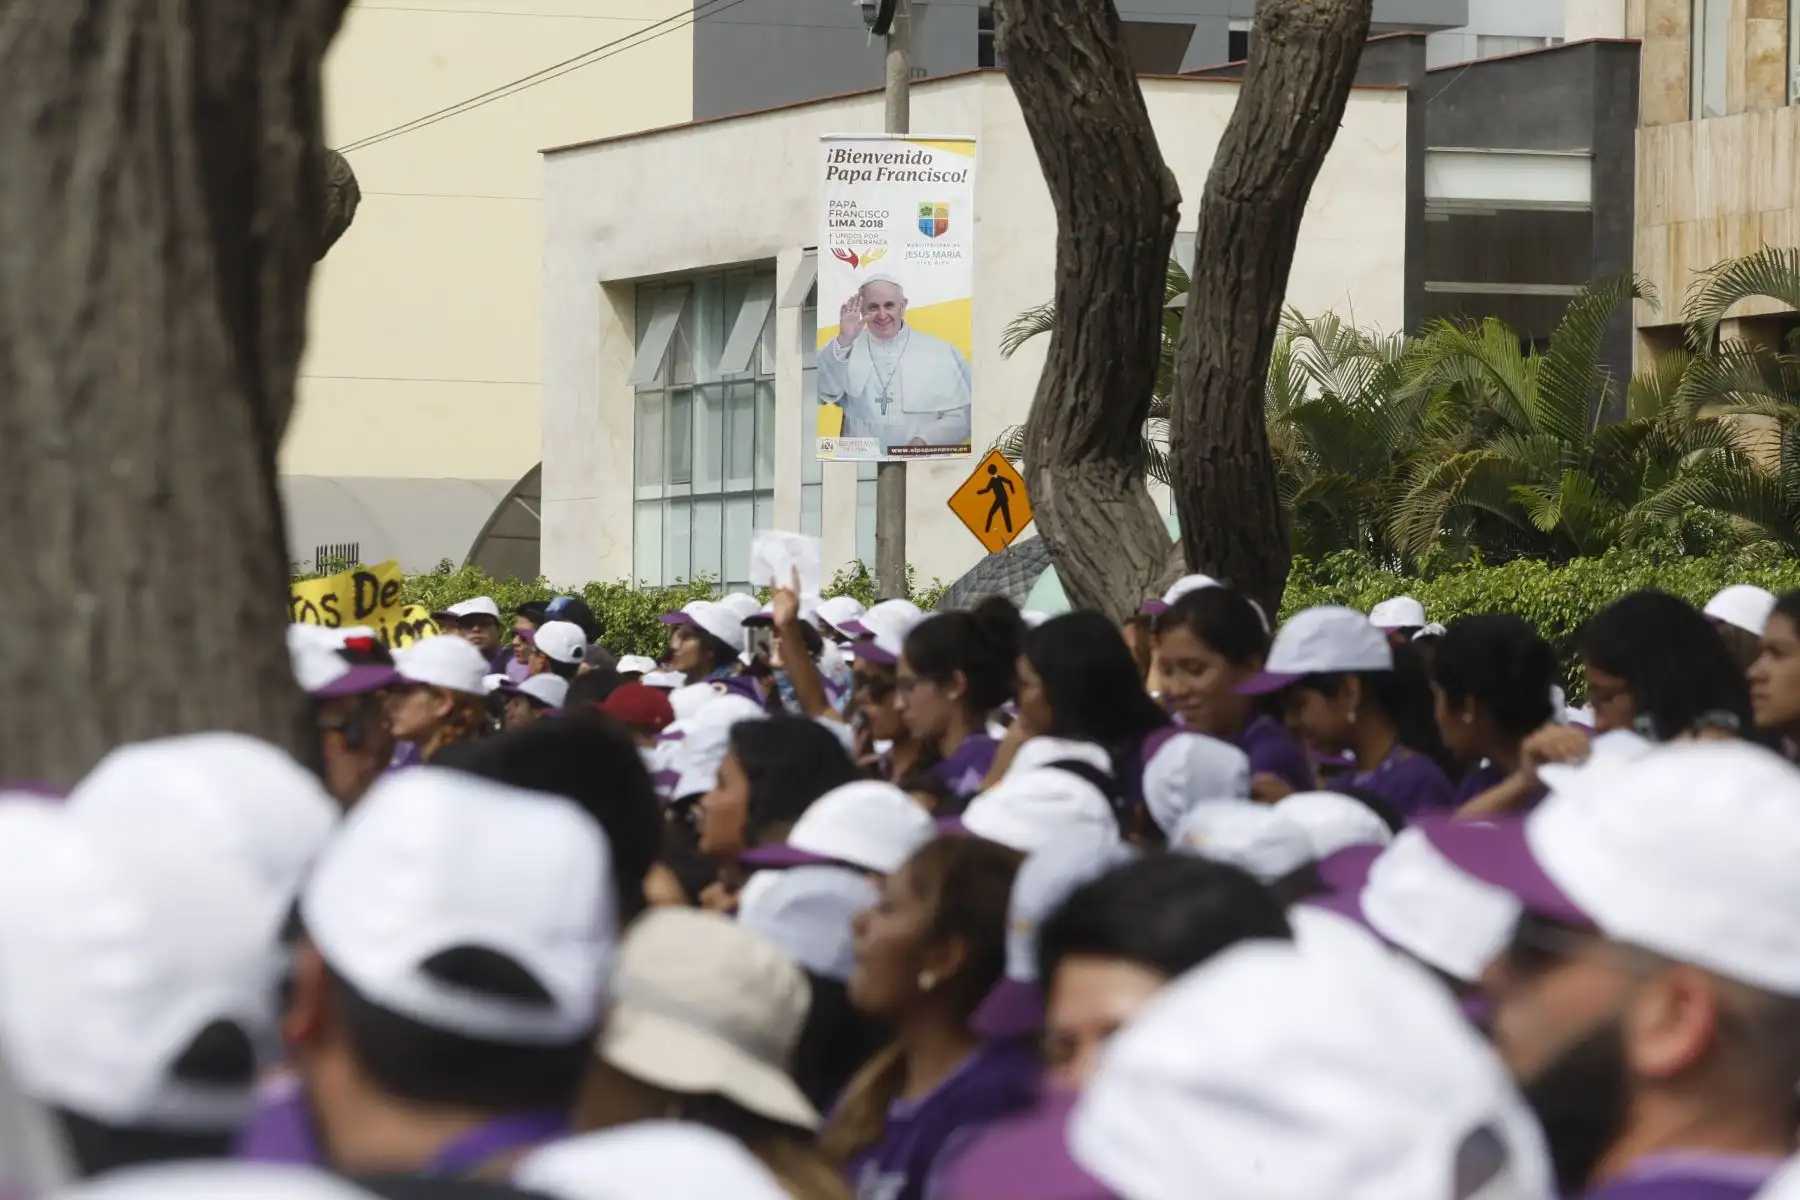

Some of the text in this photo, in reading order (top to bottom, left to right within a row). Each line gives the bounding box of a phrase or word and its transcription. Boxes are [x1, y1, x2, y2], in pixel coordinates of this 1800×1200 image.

[827, 148, 933, 165] ¡Bienvenido
[826, 165, 968, 184] Papa Francisco!
[829, 200, 857, 209] PAPA
[828, 209, 890, 219] FRANCISCO
[828, 219, 884, 228] LIMA 2018
[352, 571, 400, 620] De
